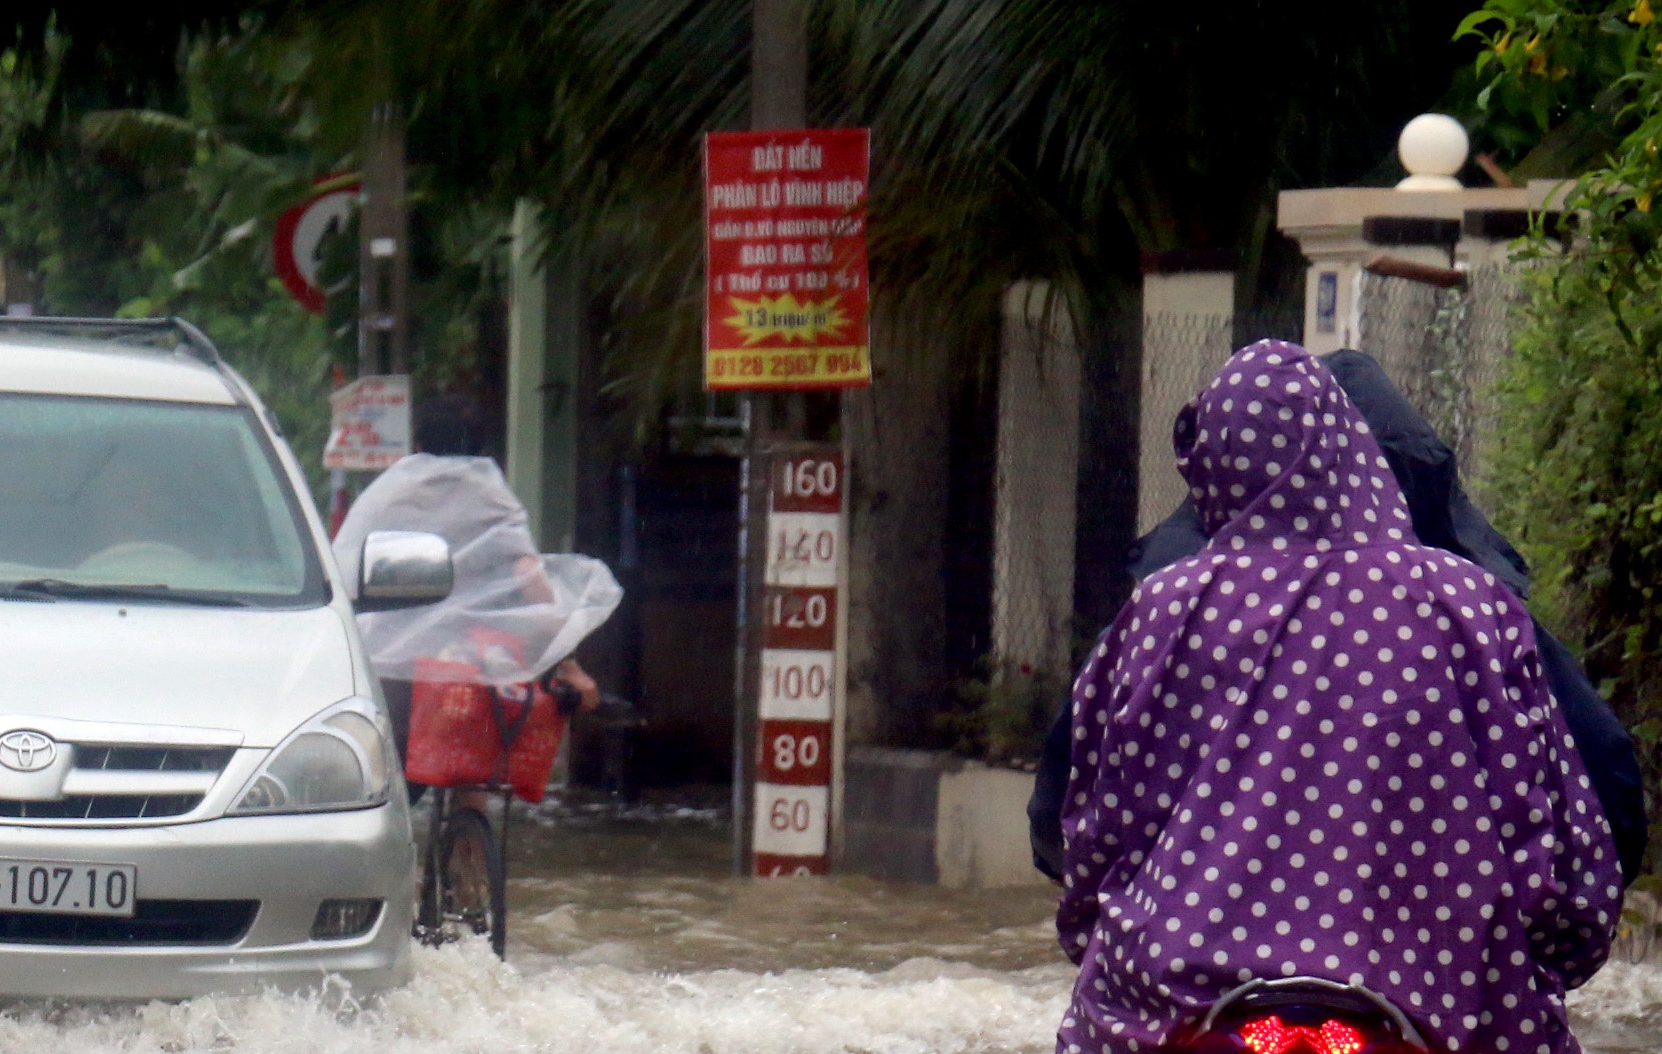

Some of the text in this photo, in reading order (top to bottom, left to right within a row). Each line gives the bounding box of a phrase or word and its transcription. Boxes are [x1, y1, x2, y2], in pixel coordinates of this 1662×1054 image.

[783, 243, 806, 265] RA
[745, 307, 769, 328] 13
[783, 459, 837, 497] 160
[776, 526, 834, 564] 140
[772, 594, 827, 628] 120
[773, 664, 825, 700] 100
[773, 734, 820, 770] 80
[770, 798, 810, 833] 60
